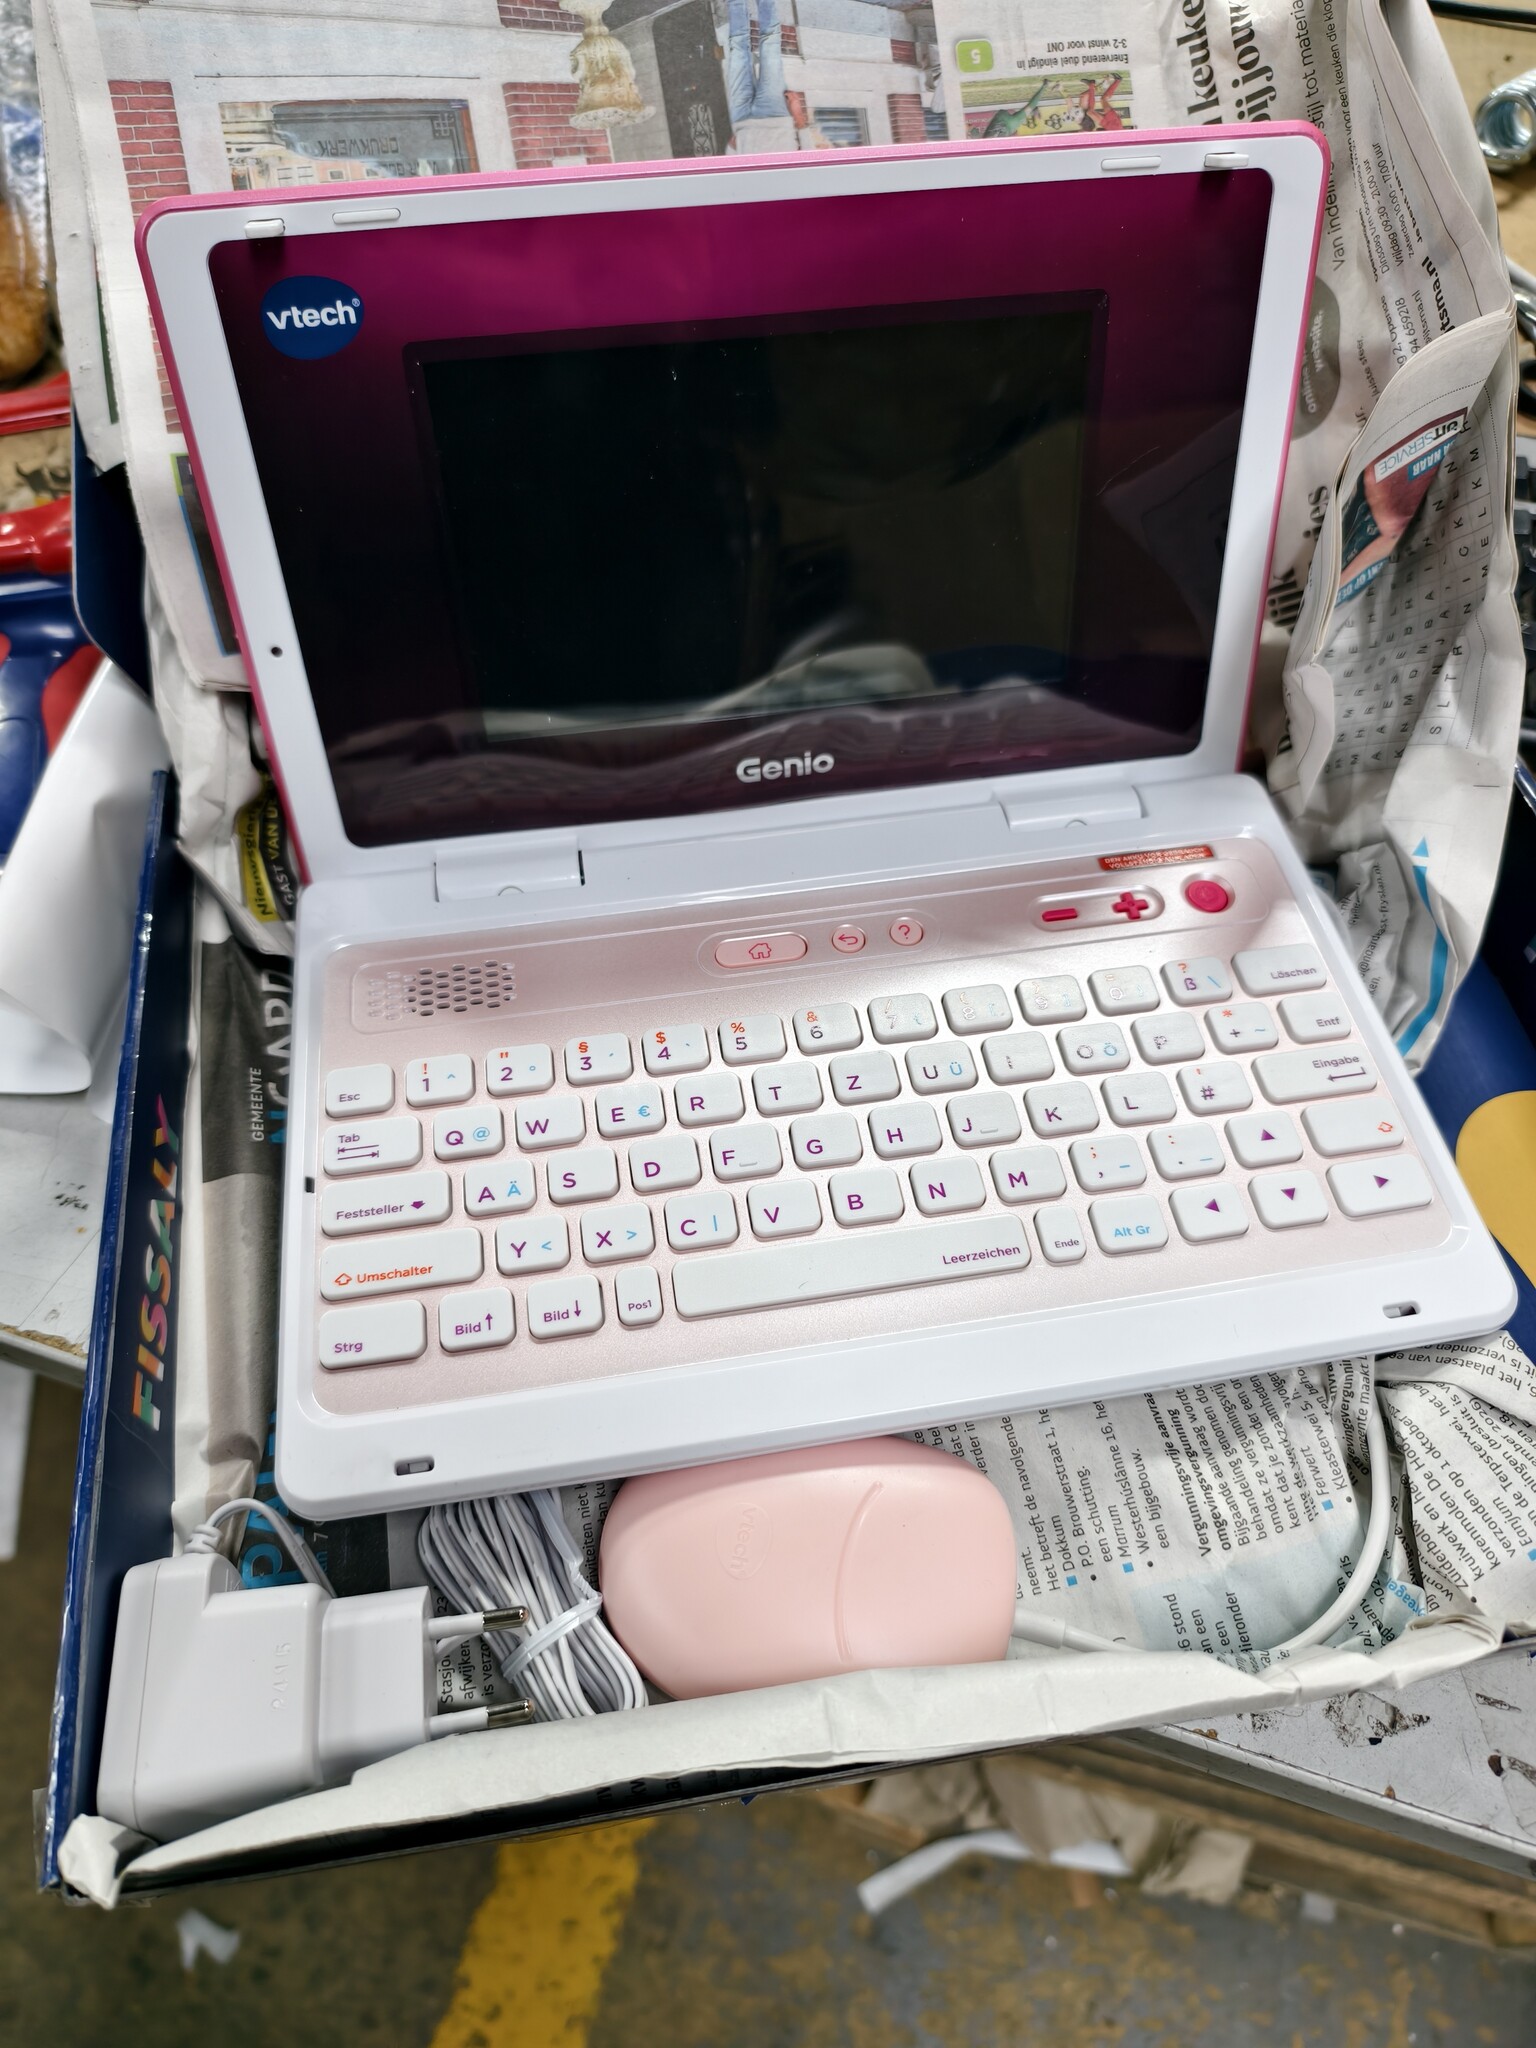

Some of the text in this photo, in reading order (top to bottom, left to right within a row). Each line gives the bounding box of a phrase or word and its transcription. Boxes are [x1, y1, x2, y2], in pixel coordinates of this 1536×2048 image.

[970, 48, 982, 65] 5
[1046, 38, 1127, 53] 3-2 winst voor ONT
[1325, 22, 1349, 87] keuken die
[1016, 53, 1129, 71] Enerverend duel eindigt in
[1302, 69, 1320, 100] tot
[1367, 175, 1381, 200] 21.00
[1371, 142, 1415, 258] Zaterdag 10.00 17.00 uur
[1376, 206, 1393, 232] 09.30
[1332, 237, 1347, 272] Van
[1372, 234, 1391, 275] Dinsdag
[1388, 231, 1405, 267] Vrijdag
[1395, 297, 1416, 336] 659218
[1412, 448, 1442, 477] NAAR
[1429, 643, 1464, 735] R S
[735, 750, 836, 784] Genio
[266, 822, 281, 861] VAN
[1104, 856, 1120, 865] DEN
[1122, 854, 1143, 863] AKKU
[274, 866, 296, 906] GAST
[1270, 964, 1318, 981] Löschen
[810, 1025, 823, 1040] 6
[1316, 1015, 1341, 1028] Entf
[656, 1046, 671, 1061] 4
[735, 1036, 748, 1051] 5
[579, 1056, 593, 1071] 3
[922, 1061, 963, 1081] U Ü
[1312, 1053, 1361, 1071] Eingabe
[500, 1066, 513, 1082] 2
[846, 1075, 862, 1091] Z
[421, 1078, 431, 1093] 1
[768, 1085, 783, 1102] T
[250, 1065, 265, 1143] GEMEENTE
[338, 1091, 362, 1104] Esc
[690, 1095, 706, 1112] R
[1123, 1096, 1140, 1111] L
[611, 1104, 651, 1124] E €
[961, 1117, 974, 1133] J
[1044, 1105, 1063, 1123] K
[337, 1131, 361, 1145] Tab
[445, 1126, 491, 1147] Q @
[525, 1118, 550, 1137] W
[886, 1127, 905, 1144] H
[806, 1138, 824, 1155] G
[721, 1150, 736, 1167] F
[562, 1172, 577, 1189] S
[643, 1161, 662, 1179] D
[1007, 1171, 1029, 1188] M
[478, 1180, 522, 1203] A Ä
[847, 1193, 865, 1211] B
[928, 1182, 947, 1200] N
[336, 1201, 405, 1221] Feststeller
[763, 1206, 780, 1224] V
[596, 1229, 613, 1248] X
[680, 1219, 698, 1237] C
[1113, 1224, 1152, 1239] Alt Gr
[510, 1240, 527, 1258] Y
[1054, 1237, 1081, 1250] Ende
[131, 1092, 181, 1433] FISSALY
[942, 1244, 1021, 1266] Leerzeichen
[356, 1263, 434, 1284] Umschalter
[543, 1308, 570, 1323] Bild
[627, 1300, 653, 1312] Pos1
[455, 1321, 482, 1336] Bild
[334, 1339, 364, 1356] Strg
[1435, 1343, 1523, 1374] is verzonden
[1407, 1352, 1523, 1392] het plaatsen van
[1360, 1362, 1372, 1407] maakt
[1448, 1393, 1502, 1451] (besluit is
[1468, 1396, 1502, 1434] 2026)
[1400, 1414, 1441, 1460] oktober
[968, 1435, 988, 1476] verder
[1210, 1382, 1285, 1535] omdat ze vergunningsvrij
[1237, 1389, 1302, 1531] kent dat je zonder een
[1308, 1414, 1349, 1491] Kleasterwei
[1428, 1395, 1530, 1510] de Terpsterwei, het
[1175, 1387, 1251, 1547] Bijgaande aanvraag wordt
[1203, 1405, 1268, 1542] behandeling genomen
[1301, 1445, 1330, 1497] Ferwert
[1100, 1420, 1150, 1556] Westerhúslânne 16,
[1167, 1408, 1232, 1552] omgevingsvergunning
[1448, 1470, 1465, 1489] op
[577, 1491, 592, 1519] niet
[1001, 1415, 1061, 1593] Het betreft de navolgende
[1049, 1440, 1095, 1568] P.O. Brouwerstraat
[1131, 1447, 1170, 1550] een bijgebouw.
[1164, 1441, 1212, 1558] Vergunningsvrije
[1076, 1465, 1114, 1564] een schutting.
[1423, 1502, 1440, 1522] en
[1423, 1470, 1501, 1571] korenmolen De
[1492, 1496, 1534, 1548] Eanjum
[1107, 1503, 1132, 1558] Marrum
[1463, 1488, 1516, 1559] verzonden
[1051, 1514, 1076, 1572] Dokkum
[1437, 1520, 1485, 1582] kruiwerk
[1021, 1545, 1042, 1597] neemt.
[435, 1595, 450, 1614] 23
[1162, 1593, 1188, 1636] stond
[1190, 1608, 1207, 1635] een
[1215, 1620, 1231, 1648] een
[458, 1637, 475, 1700] afwijken
[482, 1682, 495, 1698] is
